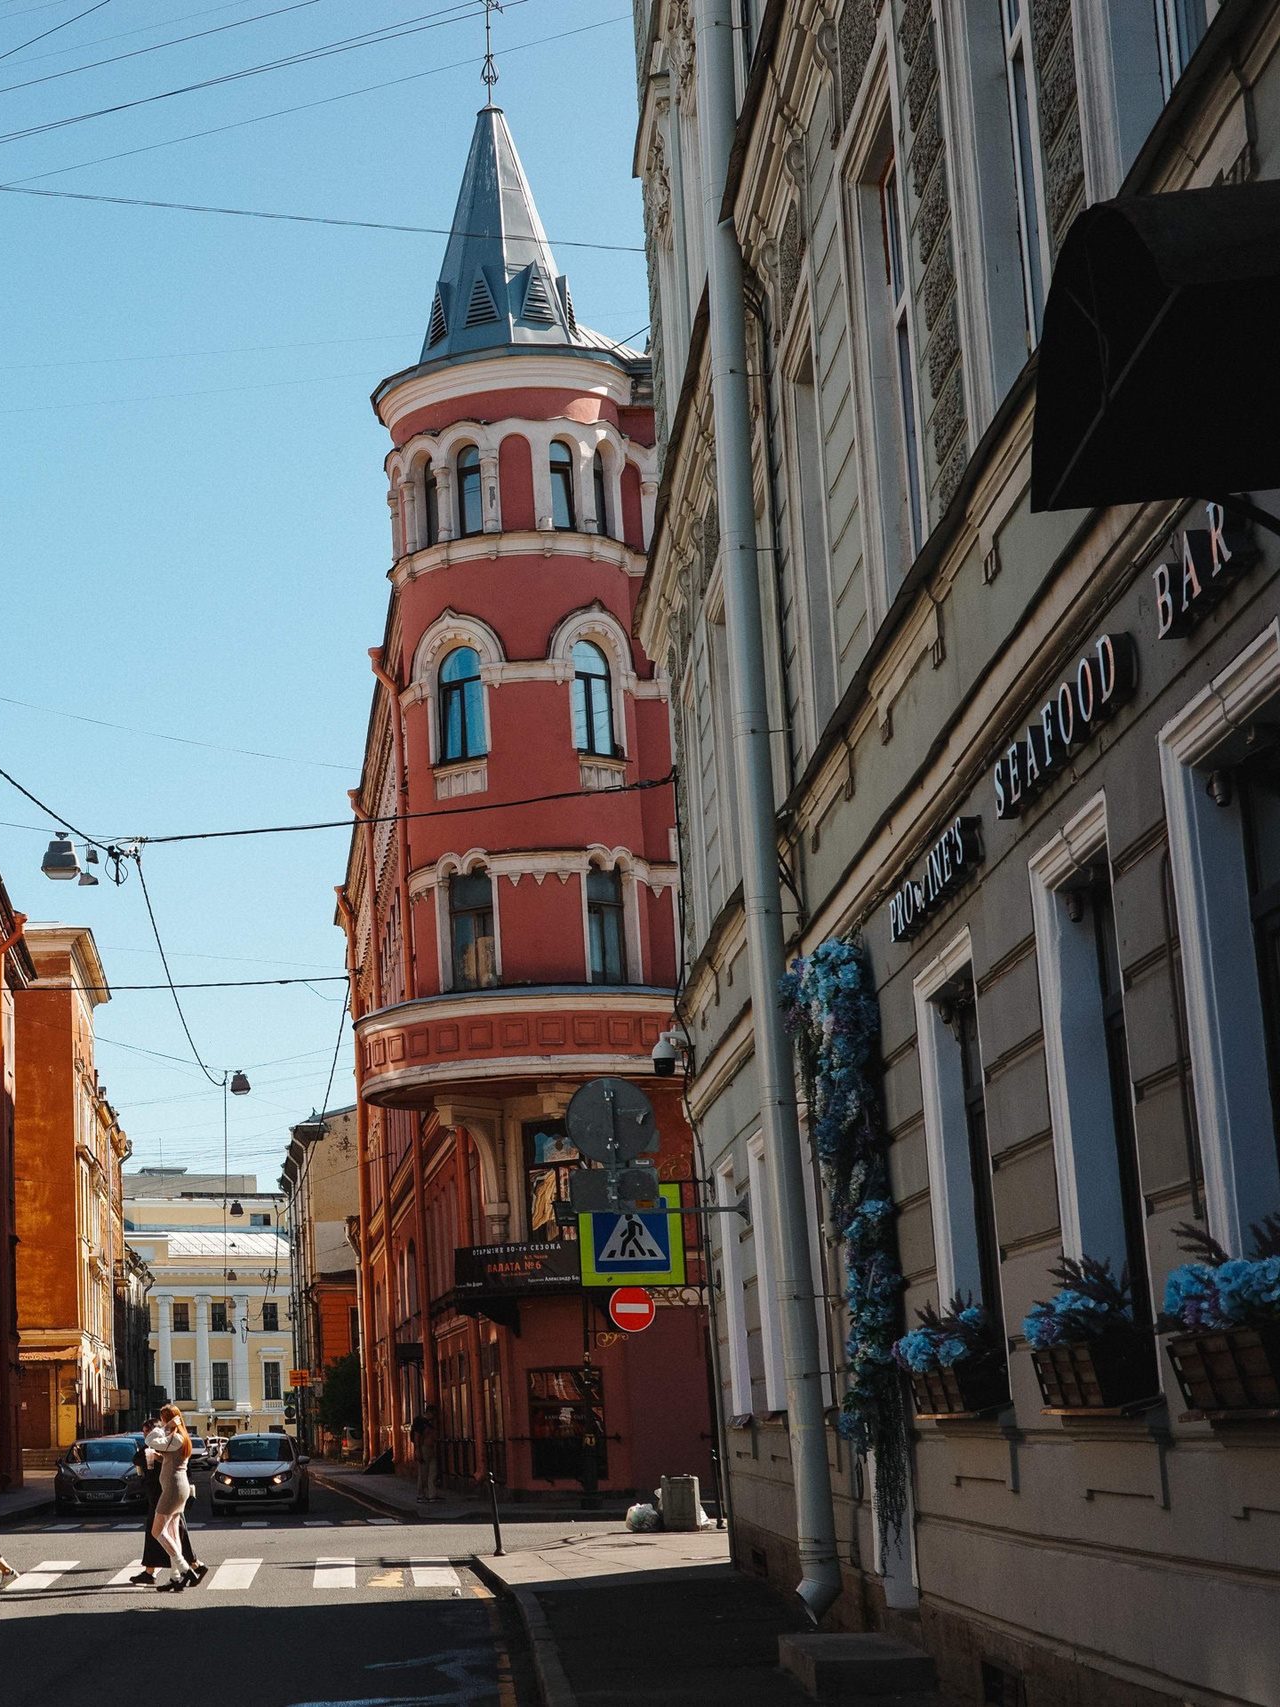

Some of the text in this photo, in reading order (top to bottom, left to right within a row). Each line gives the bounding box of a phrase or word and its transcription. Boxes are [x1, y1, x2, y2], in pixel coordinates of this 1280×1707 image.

[994, 634, 1115, 819] SEAFOOD
[1152, 501, 1232, 640] BAR
[530, 1243, 562, 1251] СЕЗОНА
[487, 1261, 521, 1273] ПАЛАТА
